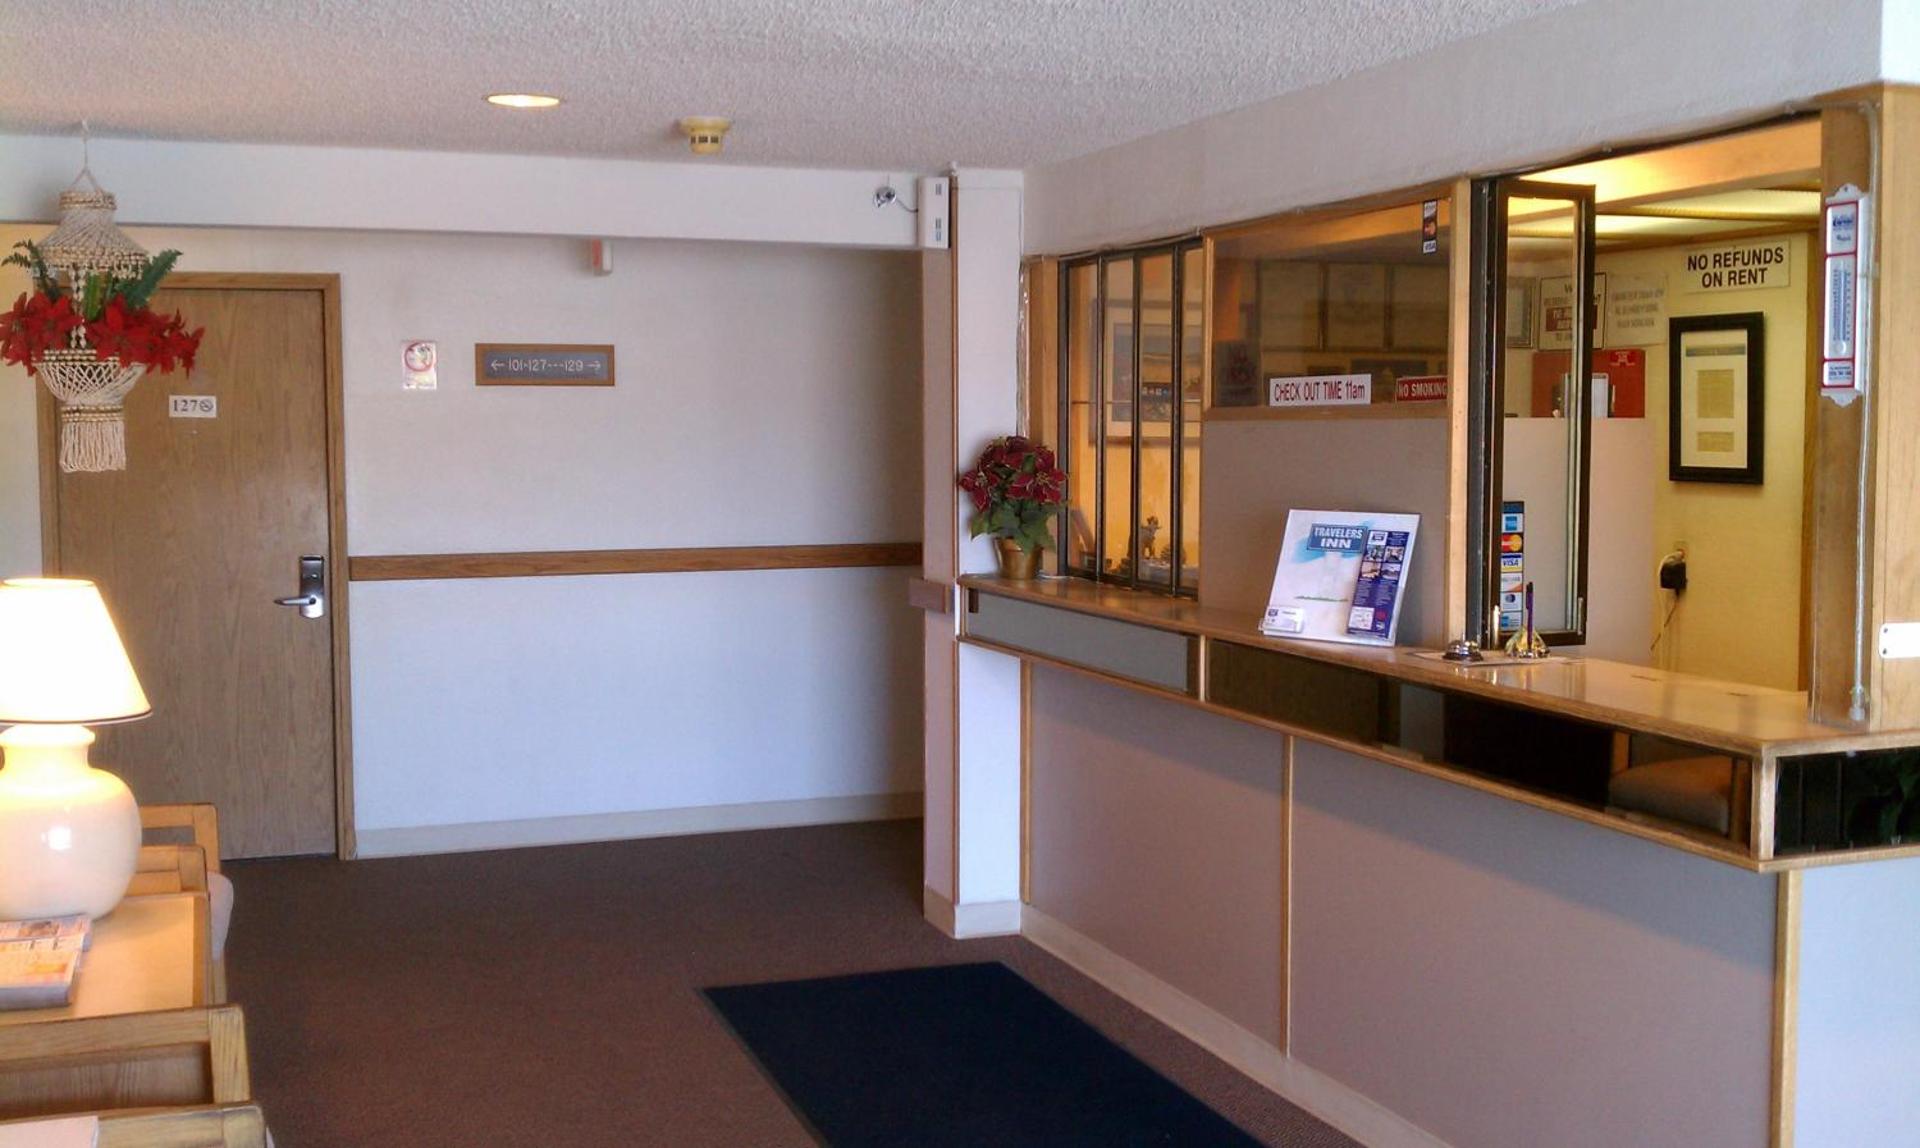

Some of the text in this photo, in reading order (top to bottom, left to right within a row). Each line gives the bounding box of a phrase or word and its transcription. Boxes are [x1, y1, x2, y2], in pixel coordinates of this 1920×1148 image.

[1687, 247, 1784, 271] NO REFUNDS
[1702, 267, 1767, 288] ON RENT
[1274, 381, 1365, 401] CHECK OUT TIME 11am
[1399, 382, 1447, 398] NO SMOKING
[173, 399, 198, 411] 127
[1314, 527, 1362, 538] TRAVELERS
[1320, 538, 1352, 548] INN
[1503, 559, 1519, 567] VISA
